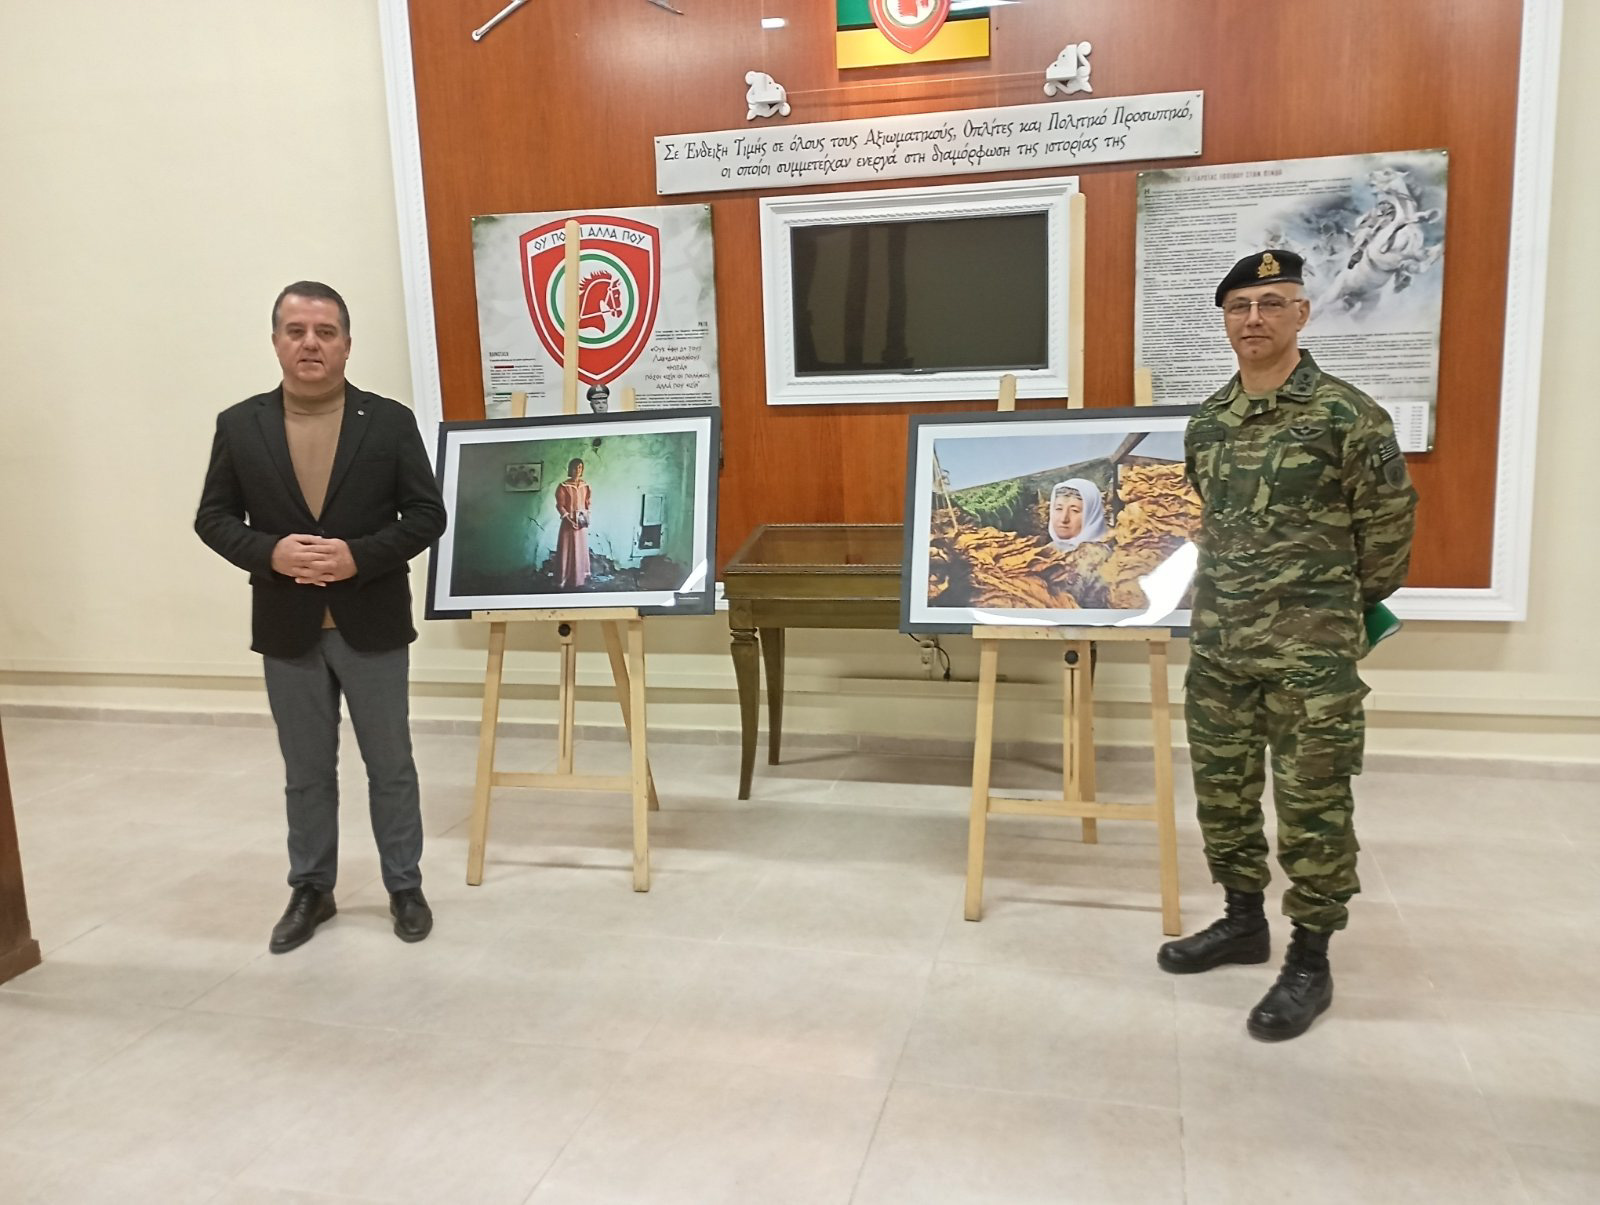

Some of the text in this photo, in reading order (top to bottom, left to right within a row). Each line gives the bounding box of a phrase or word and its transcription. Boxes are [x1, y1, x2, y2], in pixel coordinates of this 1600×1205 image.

[664, 100, 1193, 162] Σε Ένδειξη Τιμής σε όλους τους Αξιωματικούς, Οπλίτες και Πολιτικό Προσωπικό,
[721, 132, 1127, 178] οι οποίοι συμμετείχαν ενεργά στη διαμόρφωση της ιστορίας της
[534, 227, 645, 250] ΟΥ ΠΟΙ ΑΛΛΑ ΠΟΥ
